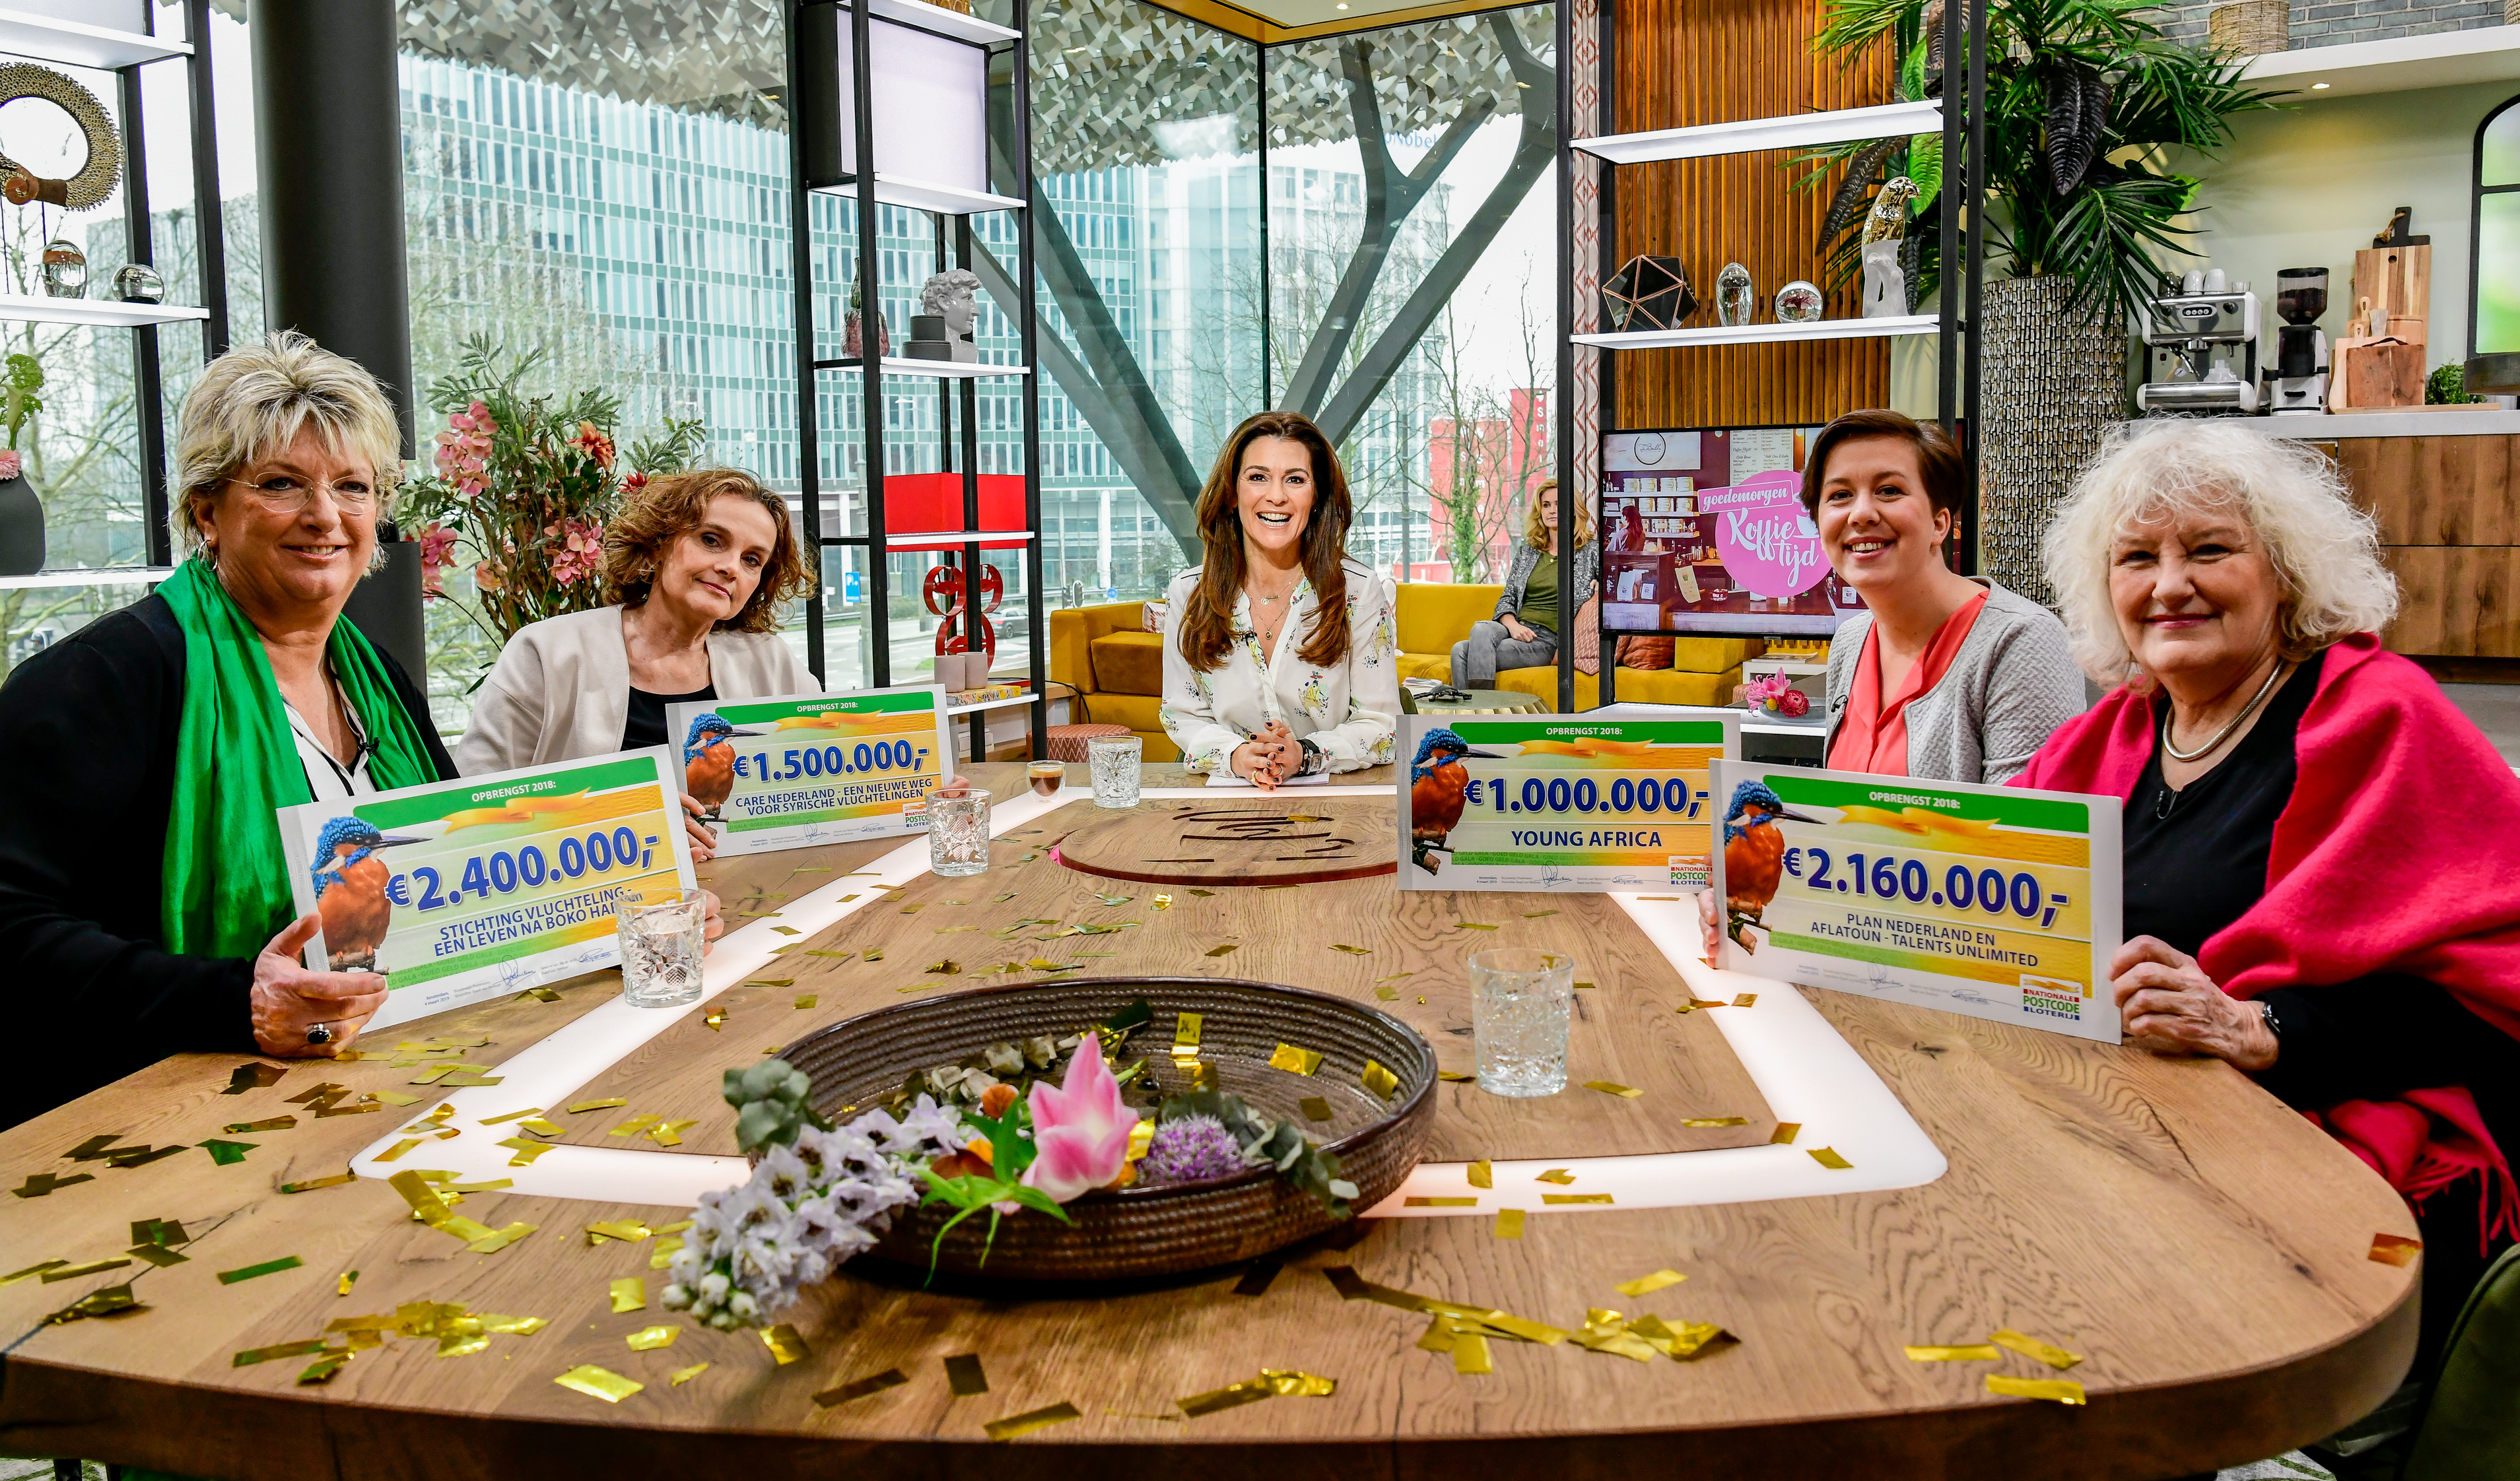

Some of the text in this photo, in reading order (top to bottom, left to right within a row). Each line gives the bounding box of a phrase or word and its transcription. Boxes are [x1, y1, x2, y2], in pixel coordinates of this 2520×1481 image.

[1703, 488, 1788, 511] goedemorgen
[1727, 508, 1795, 561] Koffie
[797, 704, 839, 713] OPBRENGST
[471, 780, 556, 802] OPBRENGST 2018:
[735, 797, 765, 808] CARE
[768, 789, 834, 805] NEDERLAND
[844, 785, 864, 795] EEN
[867, 781, 906, 793] NIEUWE
[909, 779, 932, 787] WEG
[748, 789, 924, 816] VOOR SYRISCHE VLUCHTELINGEN
[1869, 791, 1961, 809] OPBRENGST 2018:
[1512, 831, 1662, 847] YOUNG AFRICA
[440, 909, 522, 940] STICHTING
[525, 886, 624, 919] VLUCHTELING
[434, 940, 465, 956] EEN
[469, 925, 518, 949] LEVEN
[520, 920, 543, 935] NA
[546, 907, 587, 929] BOKO
[1847, 913, 1994, 946] PLAN NEDERLAND EN
[1811, 921, 1881, 943] AFLATOUN
[1891, 935, 1952, 952] TALENTS
[1956, 944, 2038, 967] UNLIMITED
[2024, 996, 2080, 1014] POSTCODE
[2029, 989, 2073, 1002] NATIONALE
[2030, 1007, 2074, 1020] LOTERIJ
